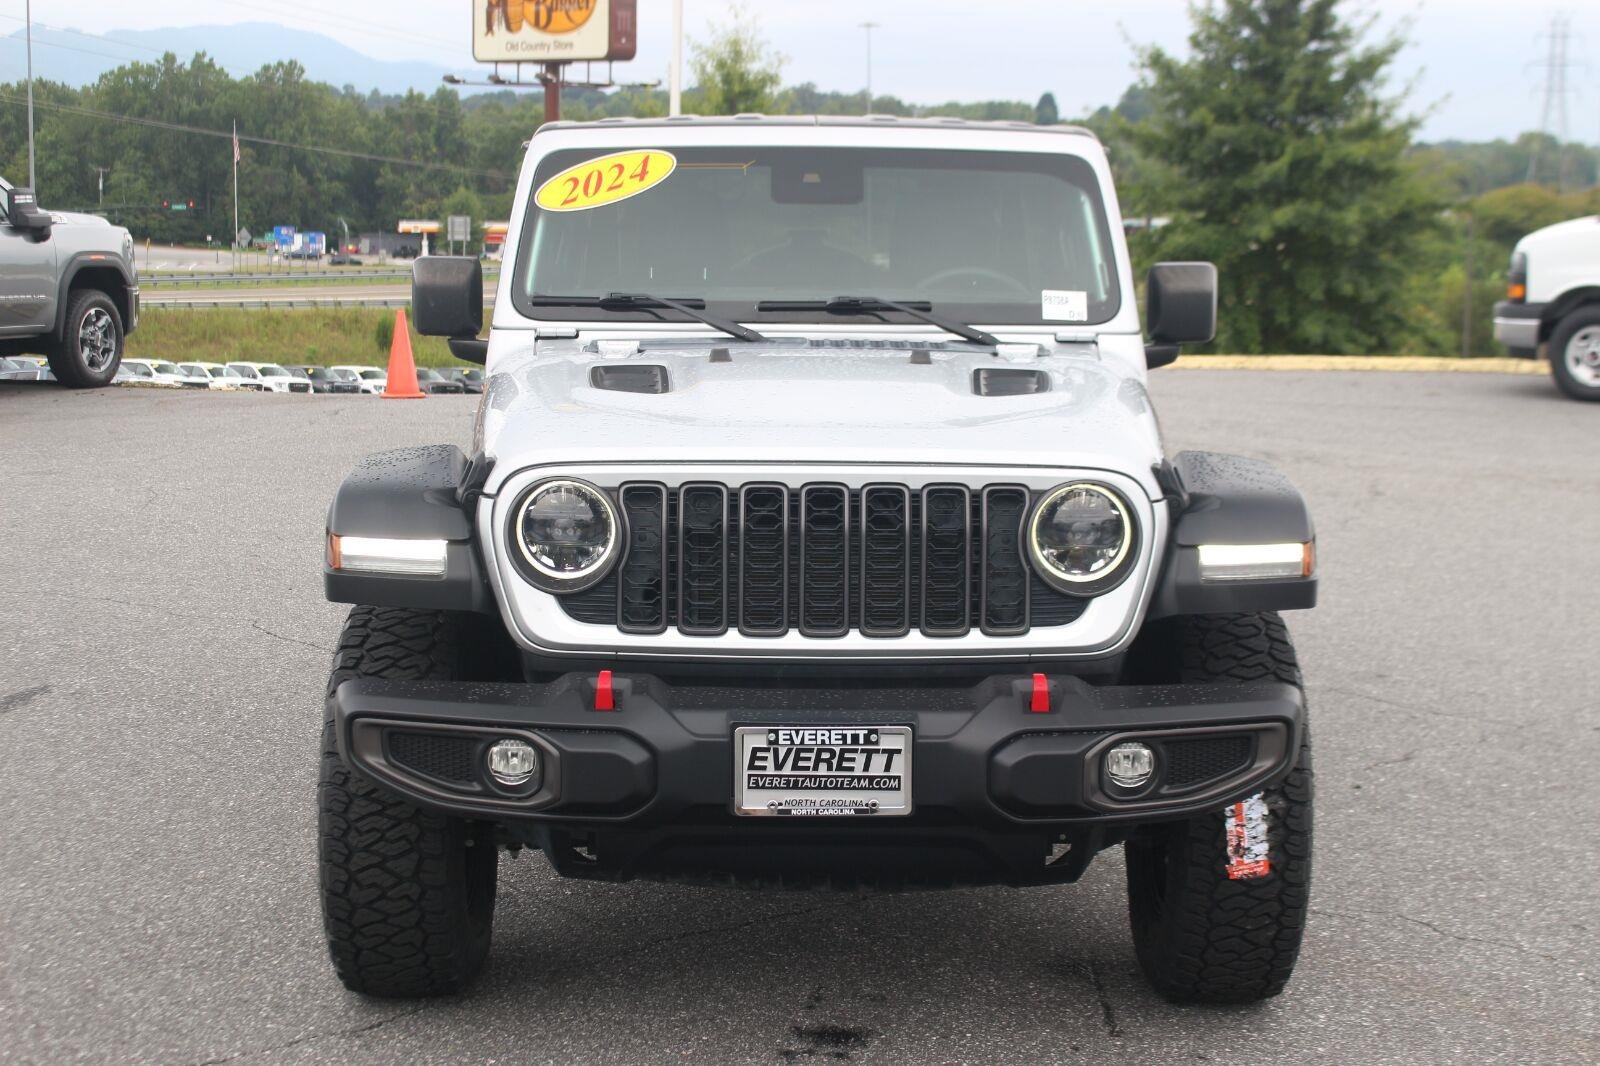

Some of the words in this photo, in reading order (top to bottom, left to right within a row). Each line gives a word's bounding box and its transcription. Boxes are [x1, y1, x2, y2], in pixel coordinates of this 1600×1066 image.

[505, 40, 519, 51] Old
[520, 40, 551, 53] Country
[553, 40, 574, 50] Store
[560, 154, 650, 206] 2024
[778, 729, 868, 745] EVERETT
[747, 747, 902, 772] EVERETT
[749, 776, 899, 789] EVERETTAUTOTEAM.COM
[784, 798, 816, 807] NORTH
[819, 799, 864, 808] CAROLINA
